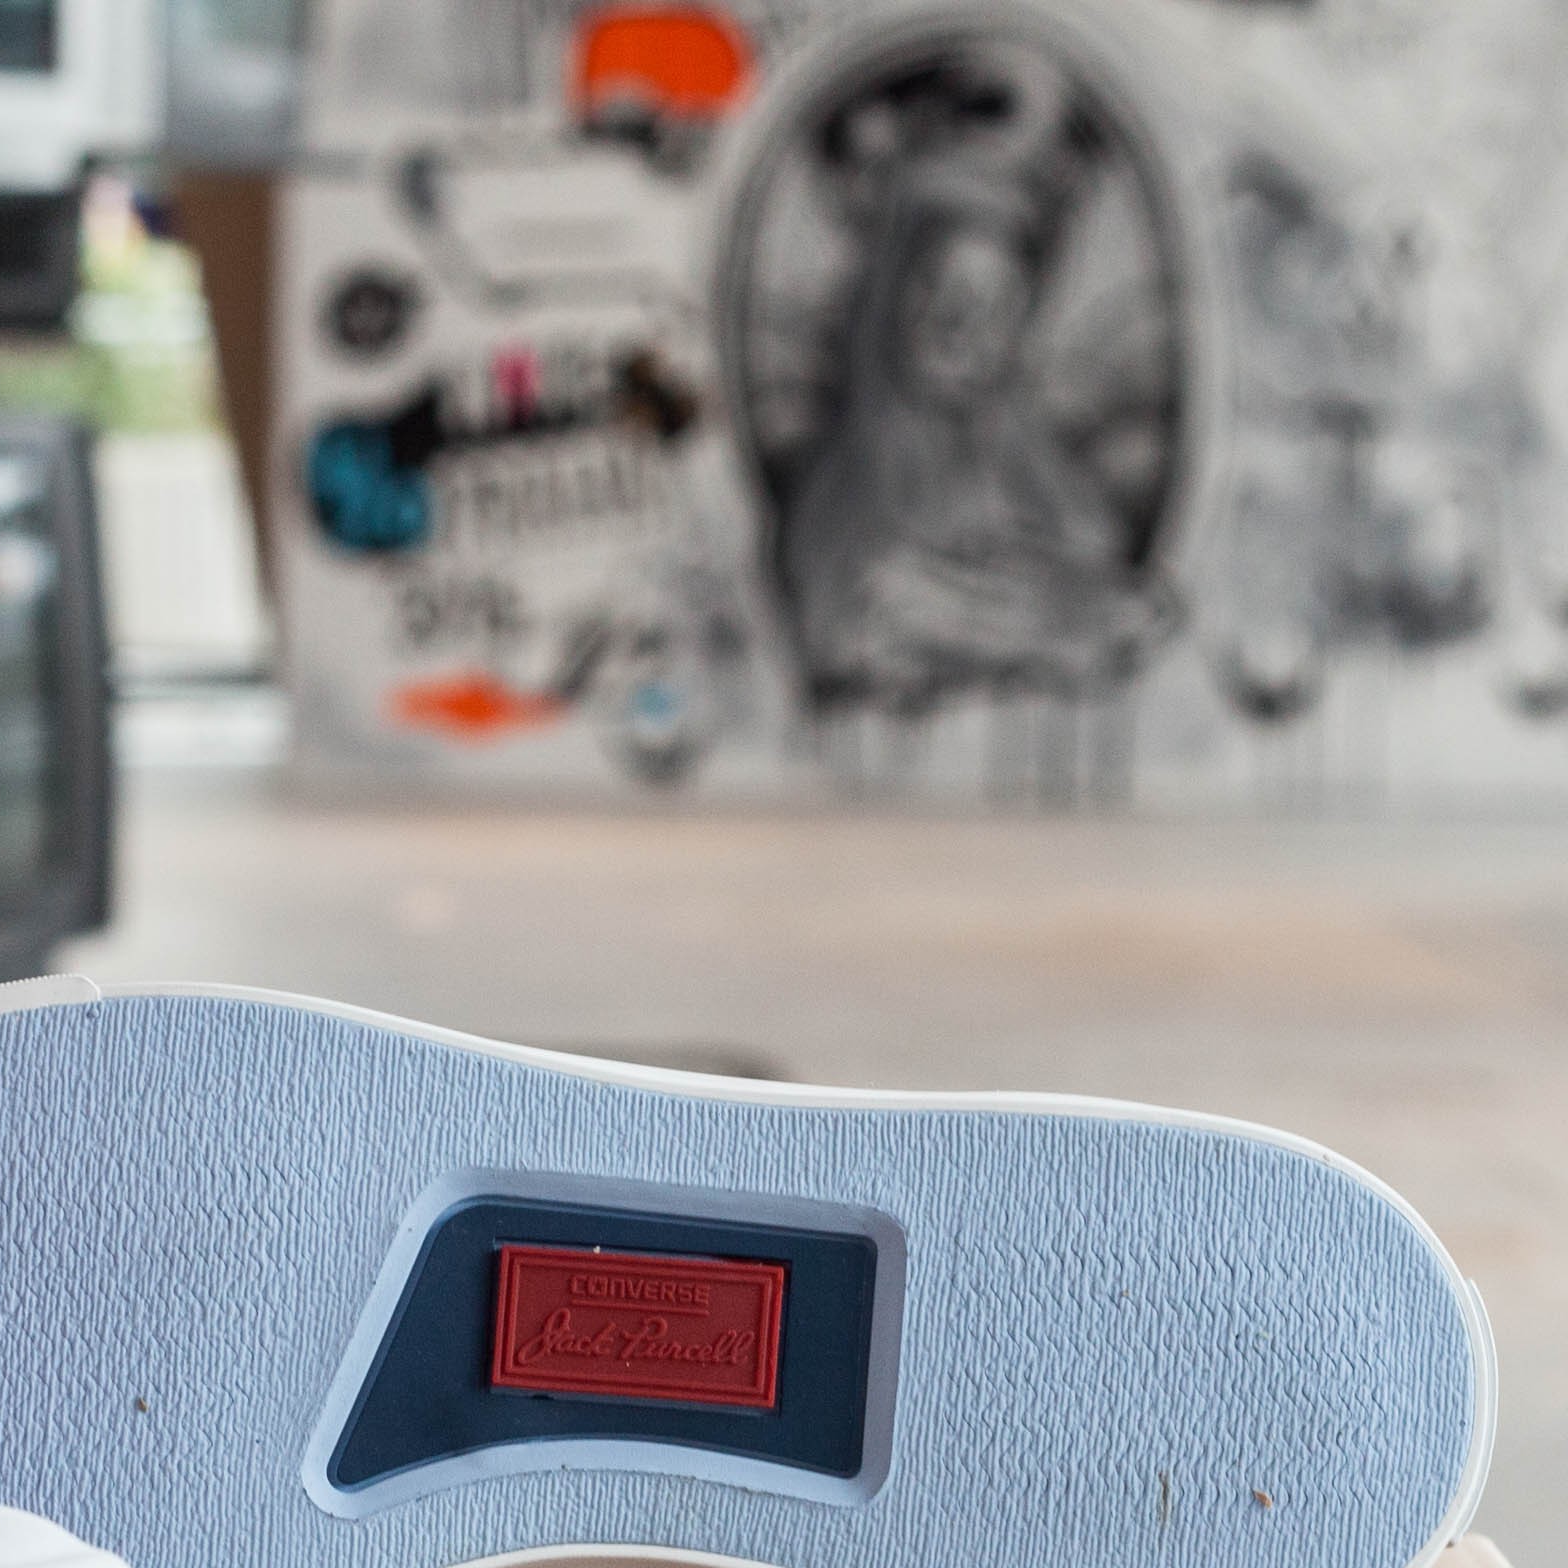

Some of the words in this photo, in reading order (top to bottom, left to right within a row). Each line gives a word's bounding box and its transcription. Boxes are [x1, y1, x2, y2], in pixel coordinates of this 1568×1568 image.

[569, 1274, 711, 1305] CONVERSE
[517, 1307, 618, 1365] Jack
[619, 1316, 755, 1364] Purcell
